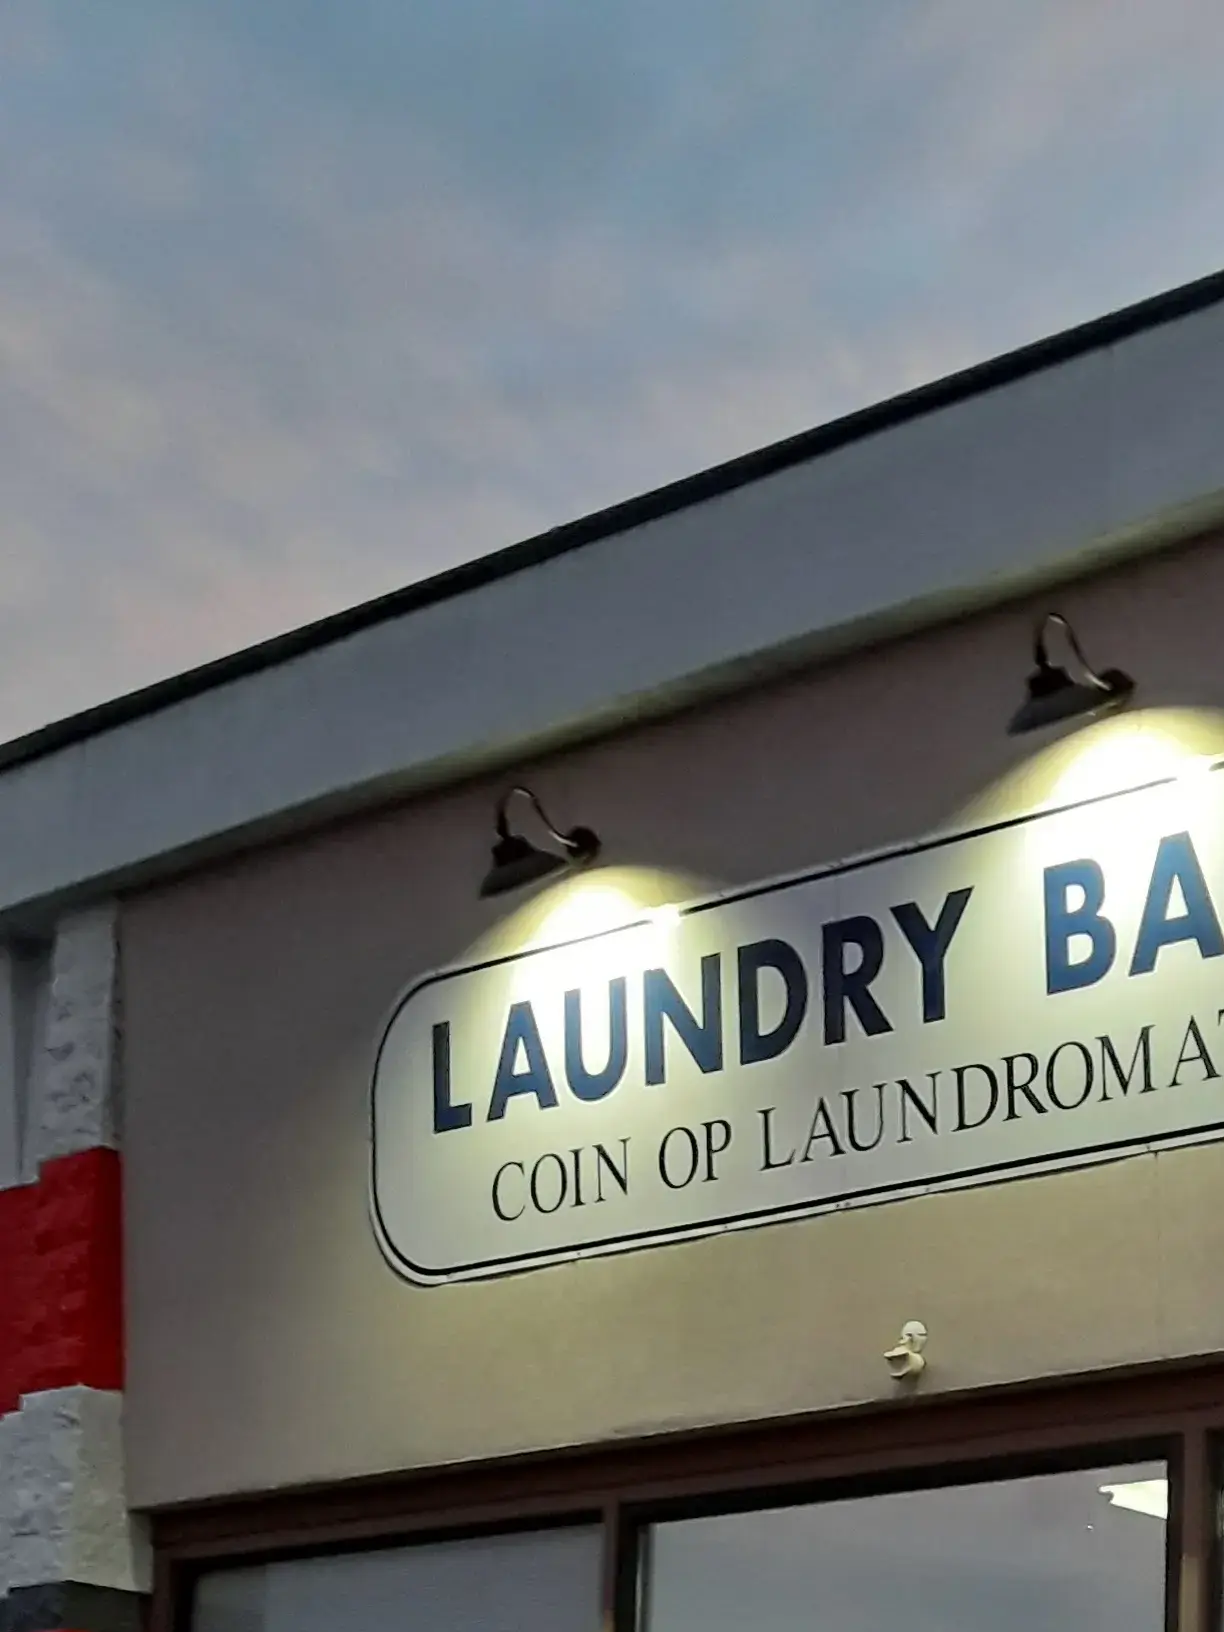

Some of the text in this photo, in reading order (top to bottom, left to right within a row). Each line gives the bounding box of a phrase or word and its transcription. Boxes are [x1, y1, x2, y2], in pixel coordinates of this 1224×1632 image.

[431, 887, 974, 1132] LAUNDRY
[492, 1137, 628, 1221] COIN
[659, 1119, 732, 1189] OP
